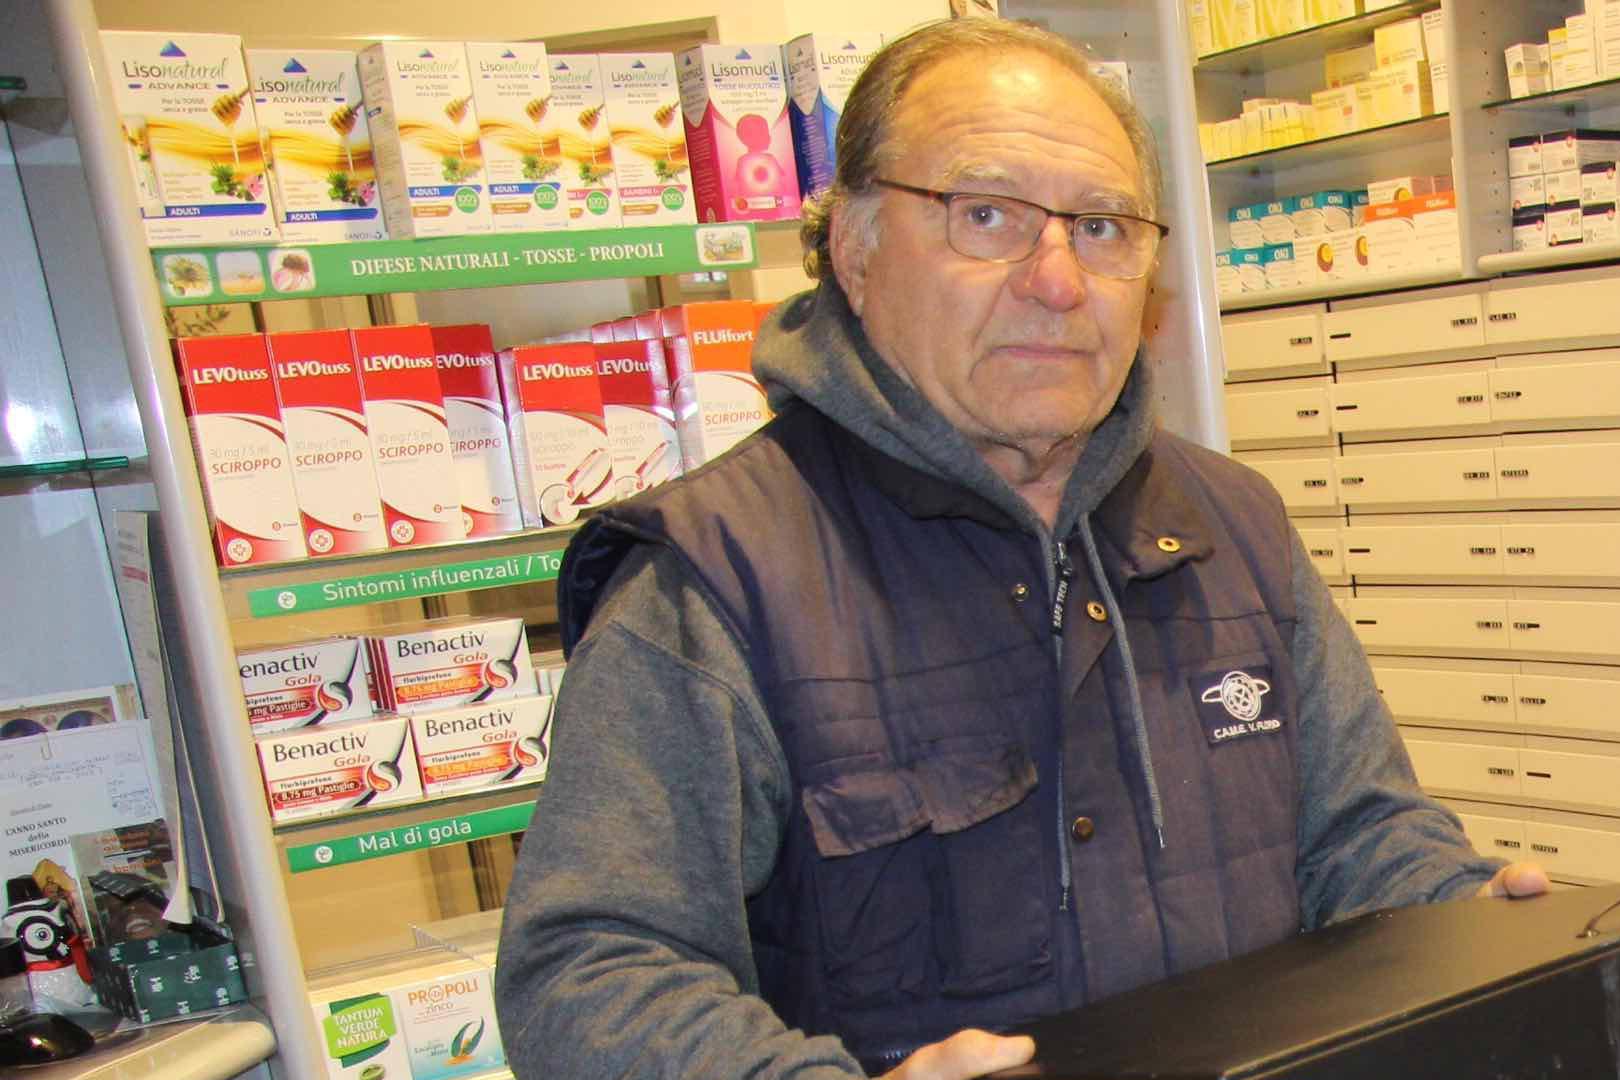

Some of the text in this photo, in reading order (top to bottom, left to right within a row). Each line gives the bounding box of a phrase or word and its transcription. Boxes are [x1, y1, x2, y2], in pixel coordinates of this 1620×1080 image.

[820, 50, 875, 66] Lisomuc
[711, 61, 778, 78] Lisomucil
[170, 207, 201, 217] ADULTI
[290, 212, 318, 222] ADULTI
[352, 258, 418, 277] DIFESE
[420, 251, 510, 272] NATURALI
[525, 247, 577, 266] TOSSE
[590, 241, 665, 261] PROPOLI
[363, 354, 434, 372] LEVOtuss
[435, 352, 494, 368] EVOtuss
[192, 366, 269, 386] LEVOtuss
[277, 360, 352, 380] LEVOtuss
[523, 362, 593, 381] LEVOtuss
[704, 410, 762, 426] SCIROPPO
[295, 449, 363, 467] SCIROPPO
[378, 442, 445, 460] SCIROPPO
[212, 456, 282, 475] SCIROPPO
[322, 578, 406, 602] Sintomi
[412, 562, 521, 590] influenzali
[396, 629, 488, 659] Benactiv
[239, 650, 321, 680] enactiv
[452, 650, 490, 665] Gola
[284, 673, 322, 688] Gola
[425, 709, 514, 738] Benactiv
[481, 729, 519, 744] Gola
[272, 731, 368, 763] Benactiv
[333, 753, 372, 768] Gola
[358, 821, 472, 854] Mal di gola
[408, 979, 480, 1007] PROPOLI
[335, 1007, 384, 1024] TANTUM
[339, 1021, 380, 1036] VERDE
[337, 1030, 388, 1048] NATURA
